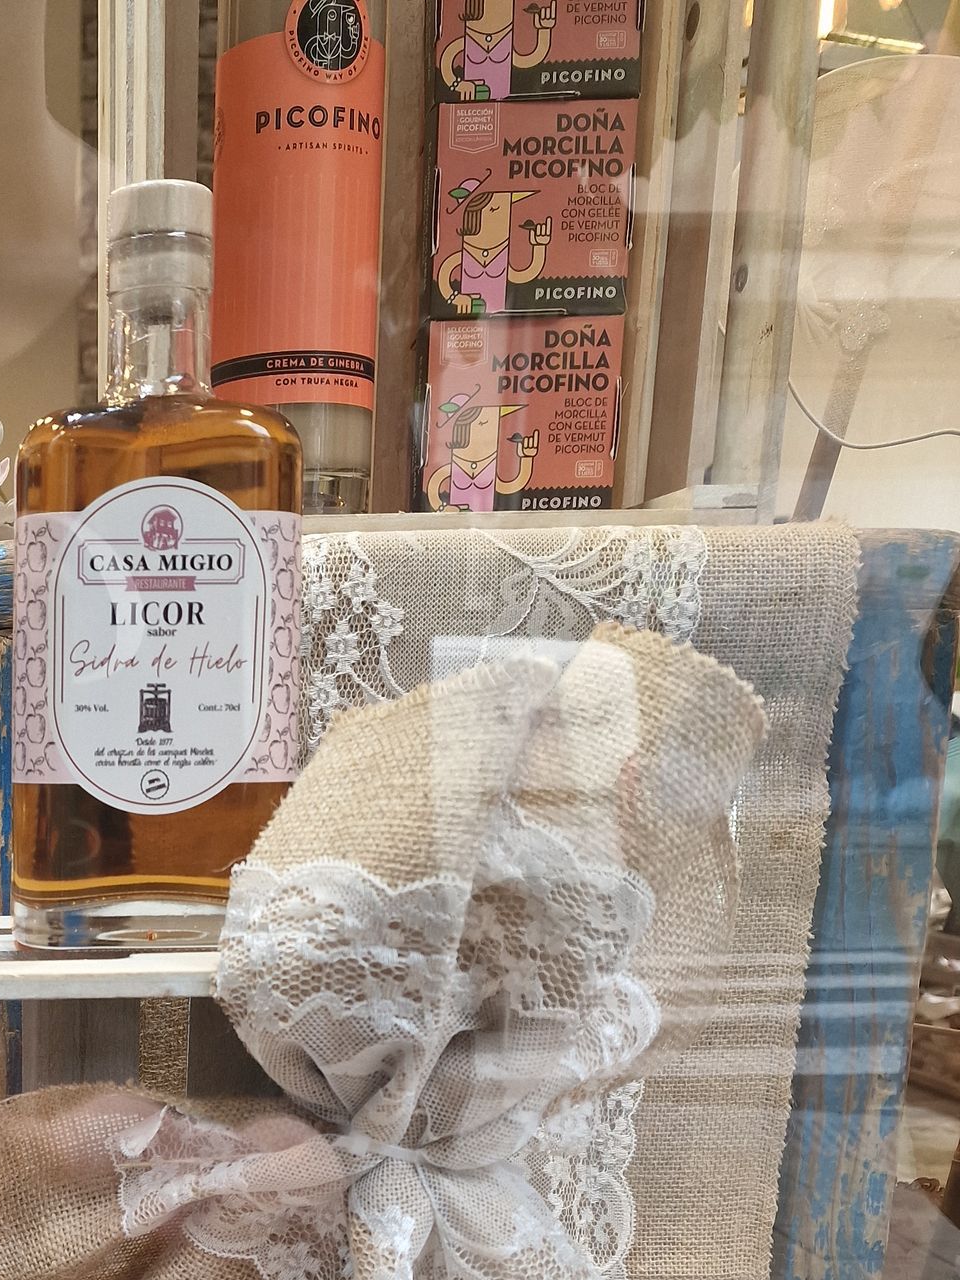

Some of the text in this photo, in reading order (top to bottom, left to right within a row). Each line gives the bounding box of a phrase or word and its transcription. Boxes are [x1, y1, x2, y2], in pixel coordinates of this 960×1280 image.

[567, 2, 628, 13] DE VERMUT
[575, 14, 627, 25] PICOFINO
[541, 68, 626, 84] PICOFINO
[256, 105, 380, 140] PICOFINO
[557, 108, 625, 132] DOÑA
[286, 142, 363, 154] ARTISAN SPIRITS
[503, 136, 624, 156] MORCILLA
[508, 158, 624, 180] PICOFINO
[577, 184, 622, 194] BLOC DE
[568, 196, 622, 206] MORCILLA
[562, 206, 620, 218] CON GELÉE
[562, 220, 620, 230] DE VERMUT
[568, 232, 620, 242] PICOFINO
[535, 287, 616, 300] PICOFINO
[544, 324, 612, 348] DOÑA
[266, 358, 364, 371] CREMA DE GINEBRA
[492, 352, 610, 372] MORCILLA
[275, 378, 296, 386] CON
[334, 379, 359, 388] NEGRA
[498, 373, 609, 394] PICOFINO
[522, 495, 602, 510] PICOFINO
[90, 554, 233, 572] CASA MIGIO
[110, 601, 205, 625] LICOR
[147, 627, 177, 637] sabor
[69, 640, 248, 678] Sidra de Hielo
